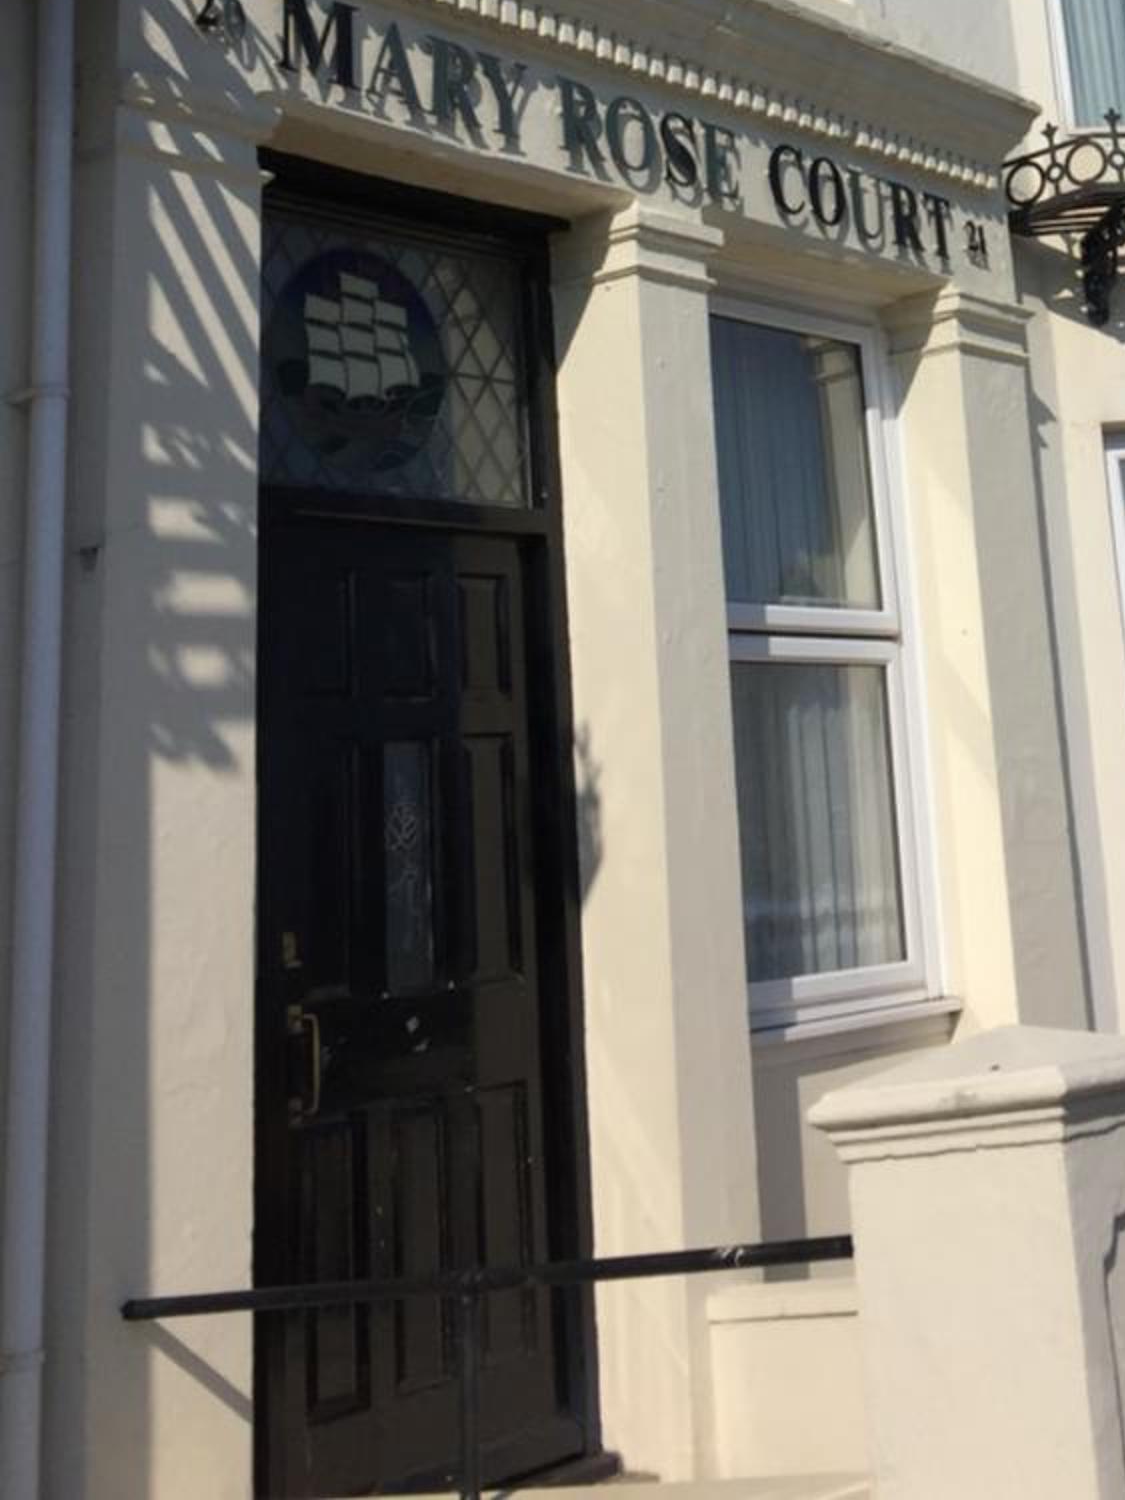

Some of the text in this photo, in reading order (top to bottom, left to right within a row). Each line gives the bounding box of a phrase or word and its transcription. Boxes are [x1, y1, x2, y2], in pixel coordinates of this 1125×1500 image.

[555, 74, 743, 204] ROSE
[768, 143, 951, 259] COURT
[963, 219, 987, 255] 21
